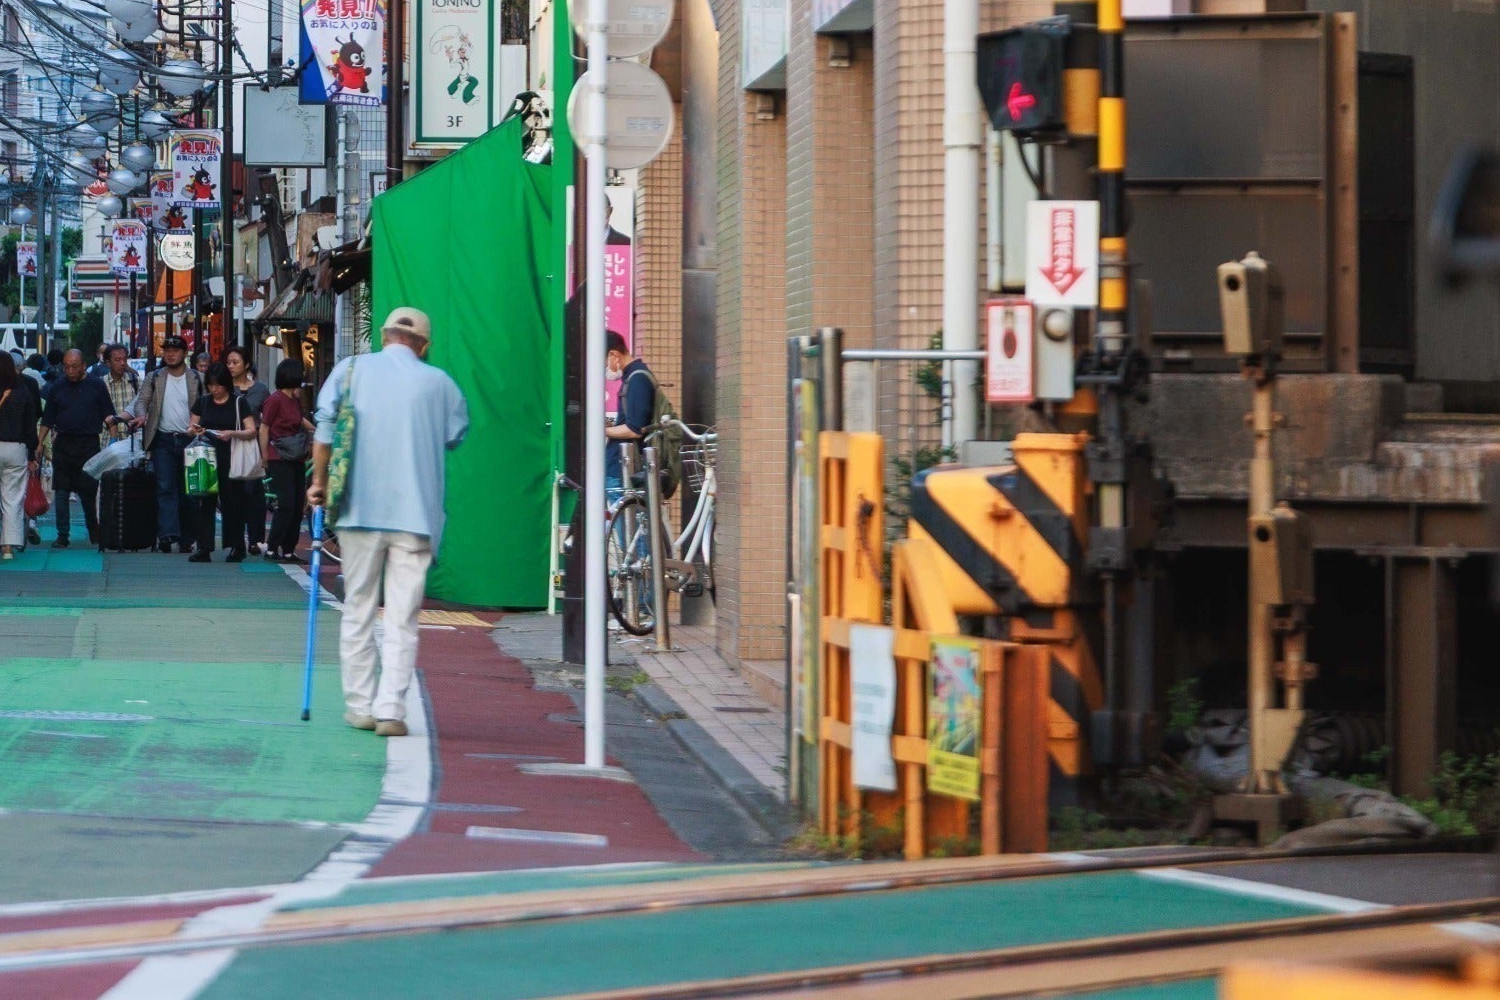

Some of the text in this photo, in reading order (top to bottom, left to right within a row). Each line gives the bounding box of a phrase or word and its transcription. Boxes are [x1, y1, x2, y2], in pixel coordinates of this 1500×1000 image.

[310, 19, 378, 31] お気に入りの店
[446, 115, 463, 128] 3F
